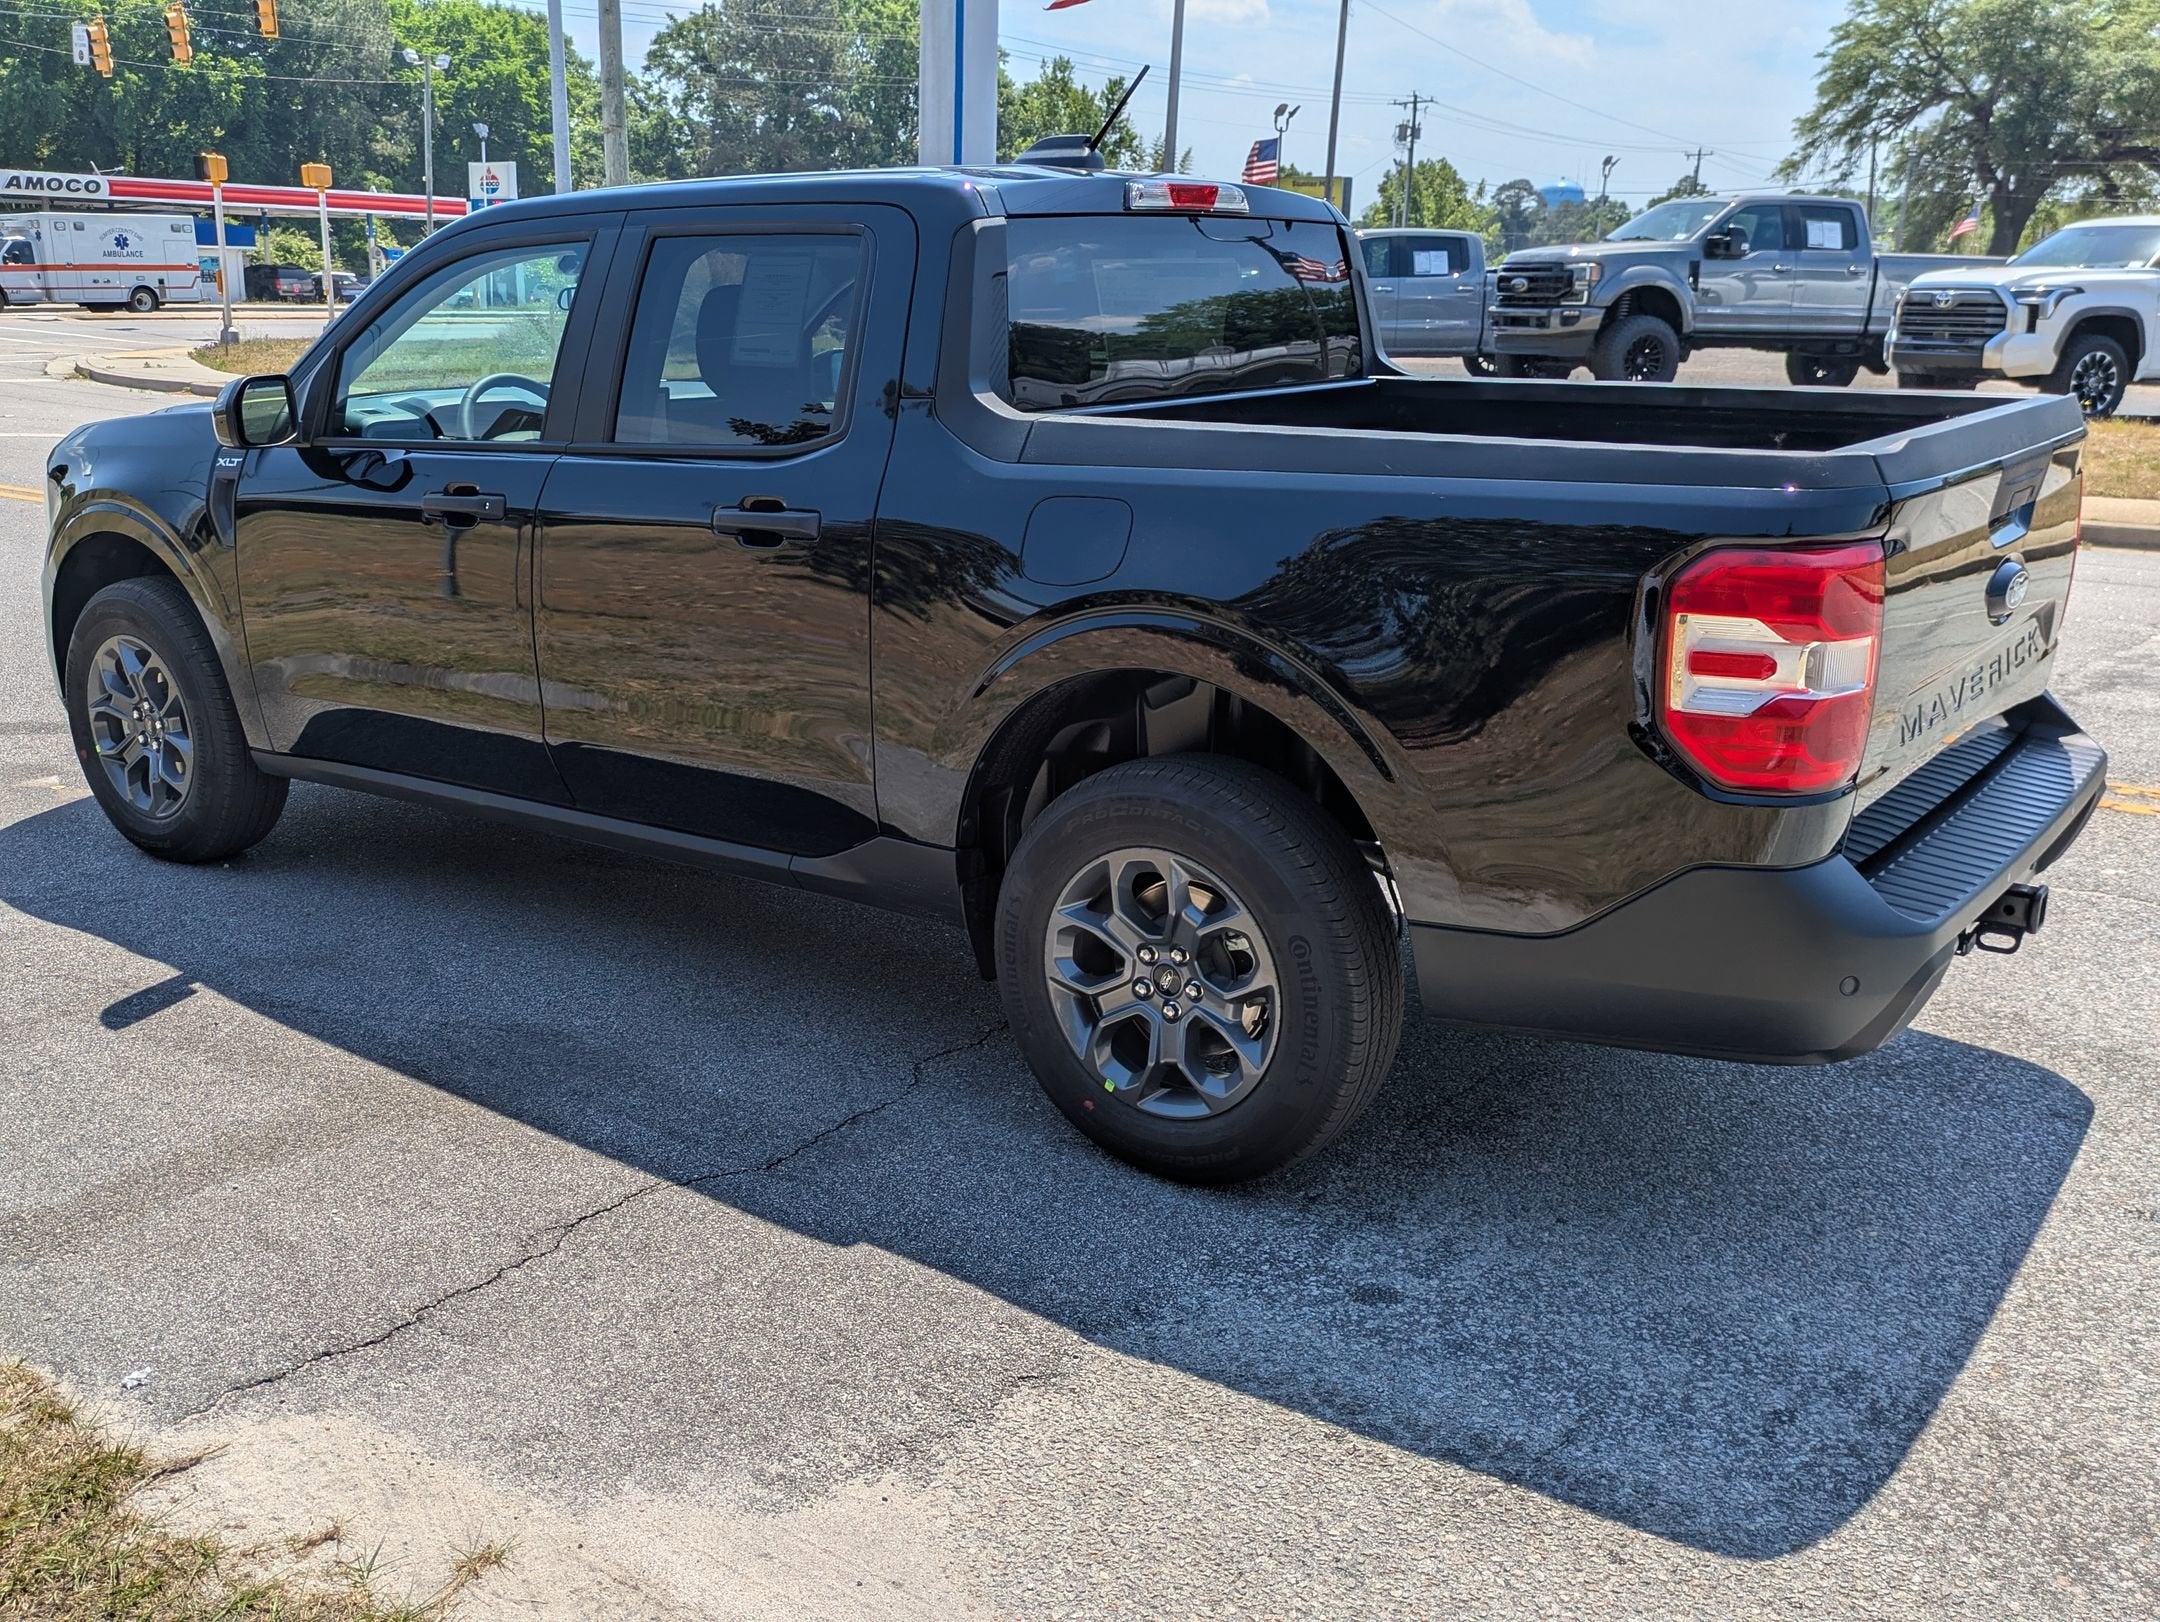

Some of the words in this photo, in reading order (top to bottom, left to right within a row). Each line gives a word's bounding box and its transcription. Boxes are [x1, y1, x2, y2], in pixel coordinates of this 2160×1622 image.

[4, 175, 101, 194] AMOCO
[102, 250, 144, 258] AMBULANCE
[215, 457, 243, 467] XLT
[1899, 625, 2039, 747] MAVERICK
[1287, 934, 1322, 1072] Continental
